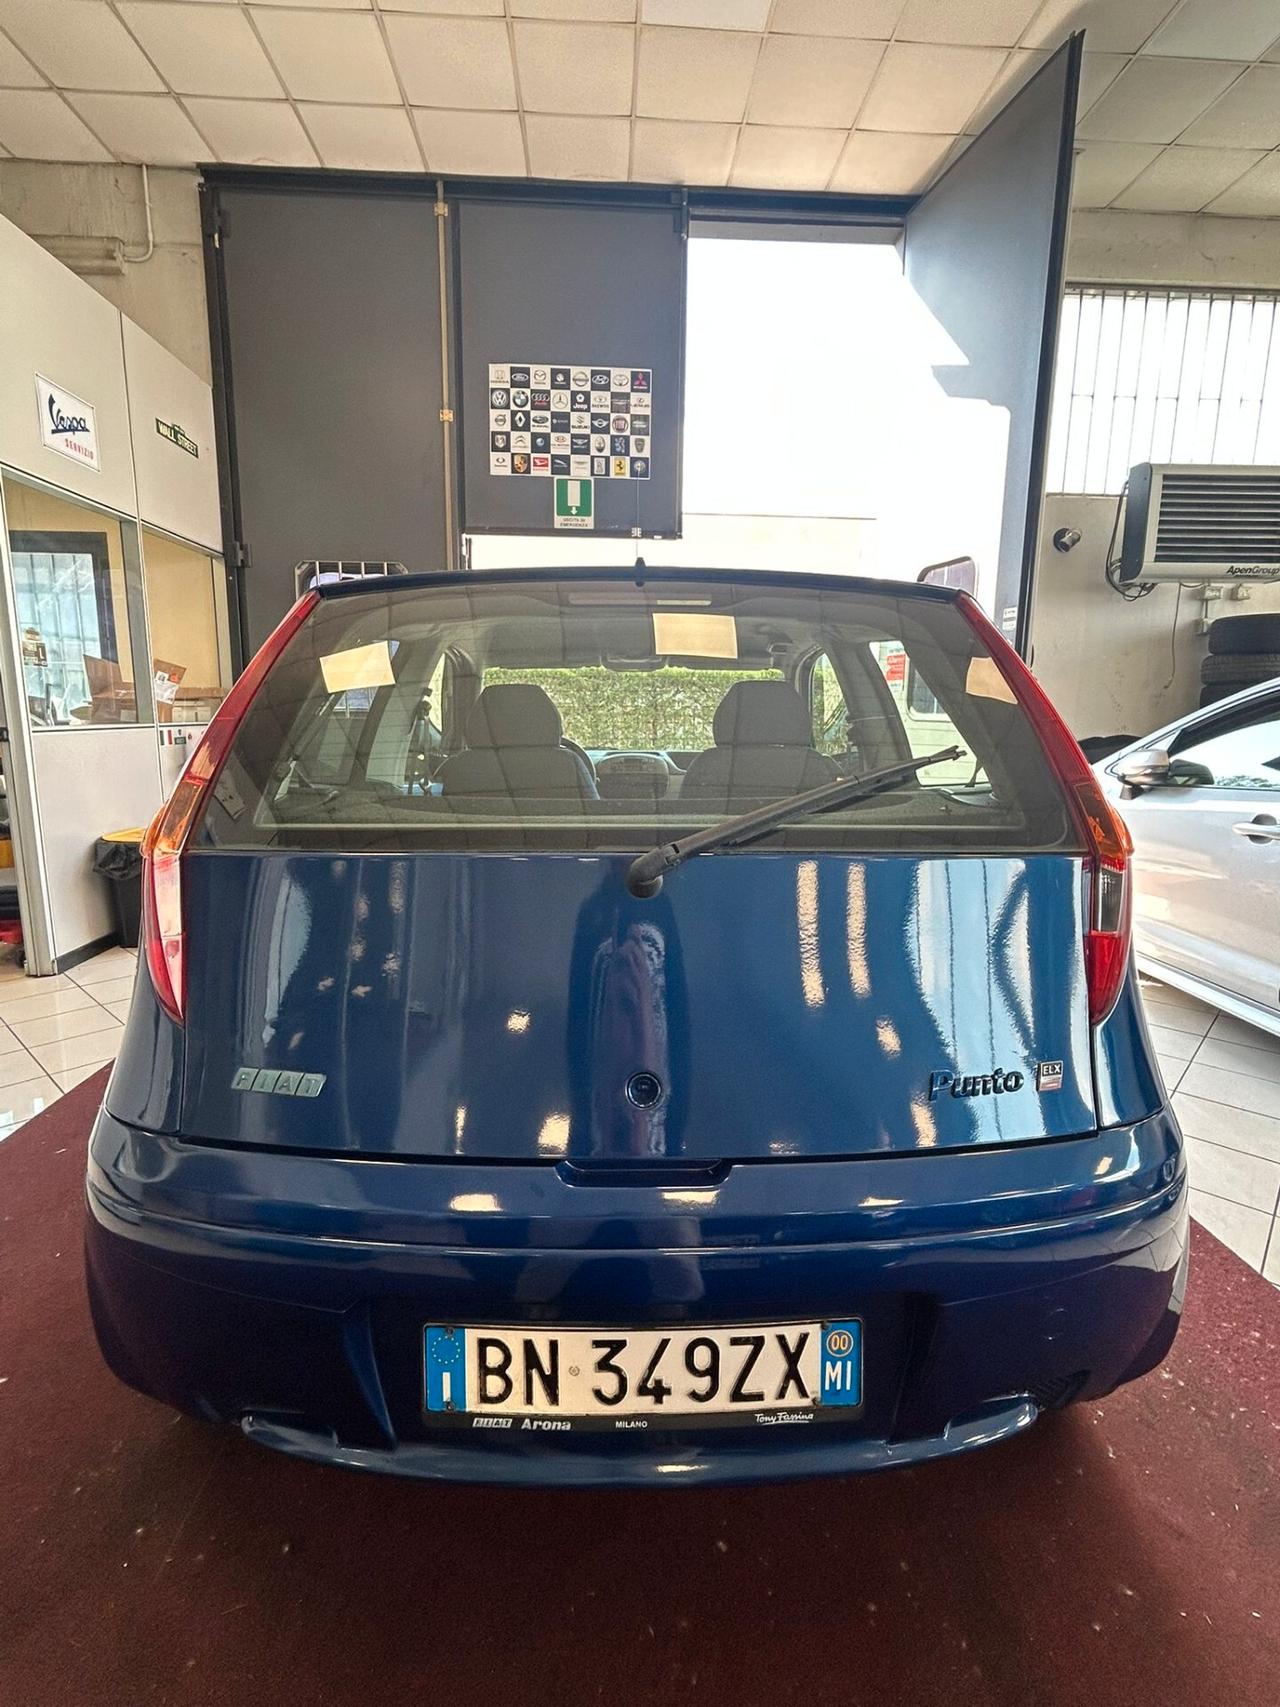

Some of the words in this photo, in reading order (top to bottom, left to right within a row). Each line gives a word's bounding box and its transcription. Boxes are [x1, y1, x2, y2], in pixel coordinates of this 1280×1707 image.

[48, 393, 90, 435] Vespa
[64, 438, 94, 460] SERVIZIO
[159, 421, 177, 442] WALL
[177, 432, 197, 456] STREET
[1226, 565, 1280, 576] ApenGroup
[1043, 1064, 1061, 1076] ELX
[233, 1069, 325, 1096] FIAT
[929, 1068, 1025, 1101] Punto
[477, 1336, 561, 1407] BN
[591, 1331, 811, 1406] 349ZX
[824, 1360, 853, 1391] MI
[472, 1417, 513, 1429] FIAT
[521, 1418, 572, 1431] Arona
[615, 1420, 648, 1429] MILANO
[754, 1412, 777, 1424] Tony
